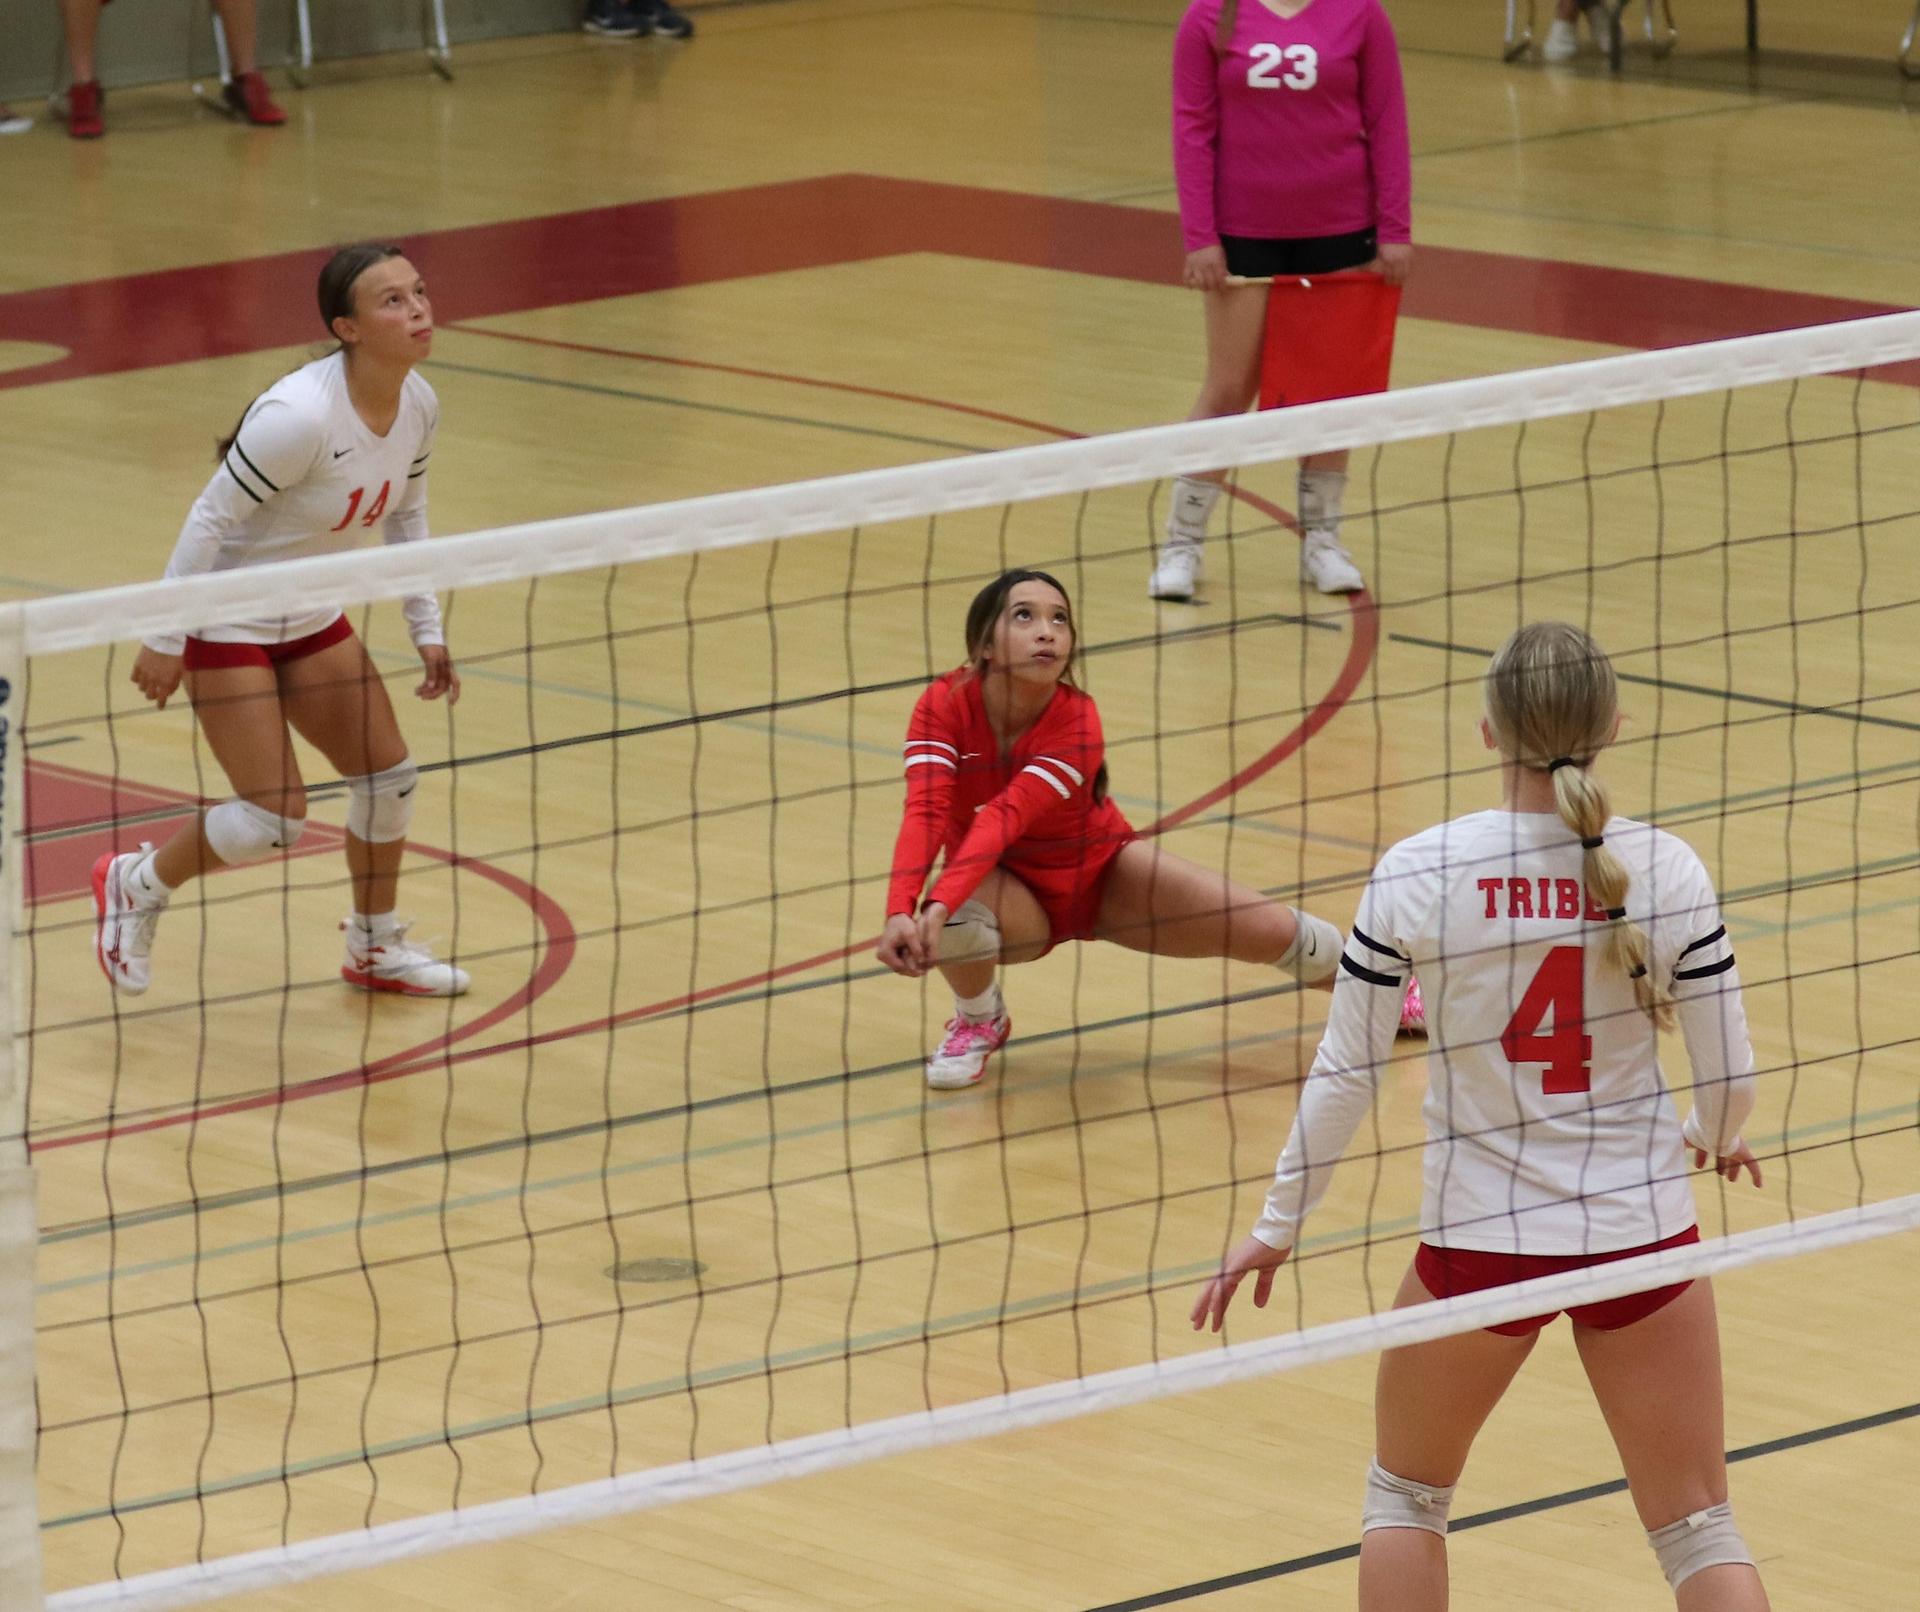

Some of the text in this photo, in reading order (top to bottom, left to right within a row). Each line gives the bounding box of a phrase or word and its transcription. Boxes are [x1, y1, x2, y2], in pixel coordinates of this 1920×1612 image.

[1247, 43, 1318, 91] 23
[330, 479, 390, 532] 14
[1500, 945, 1593, 1094] 4
